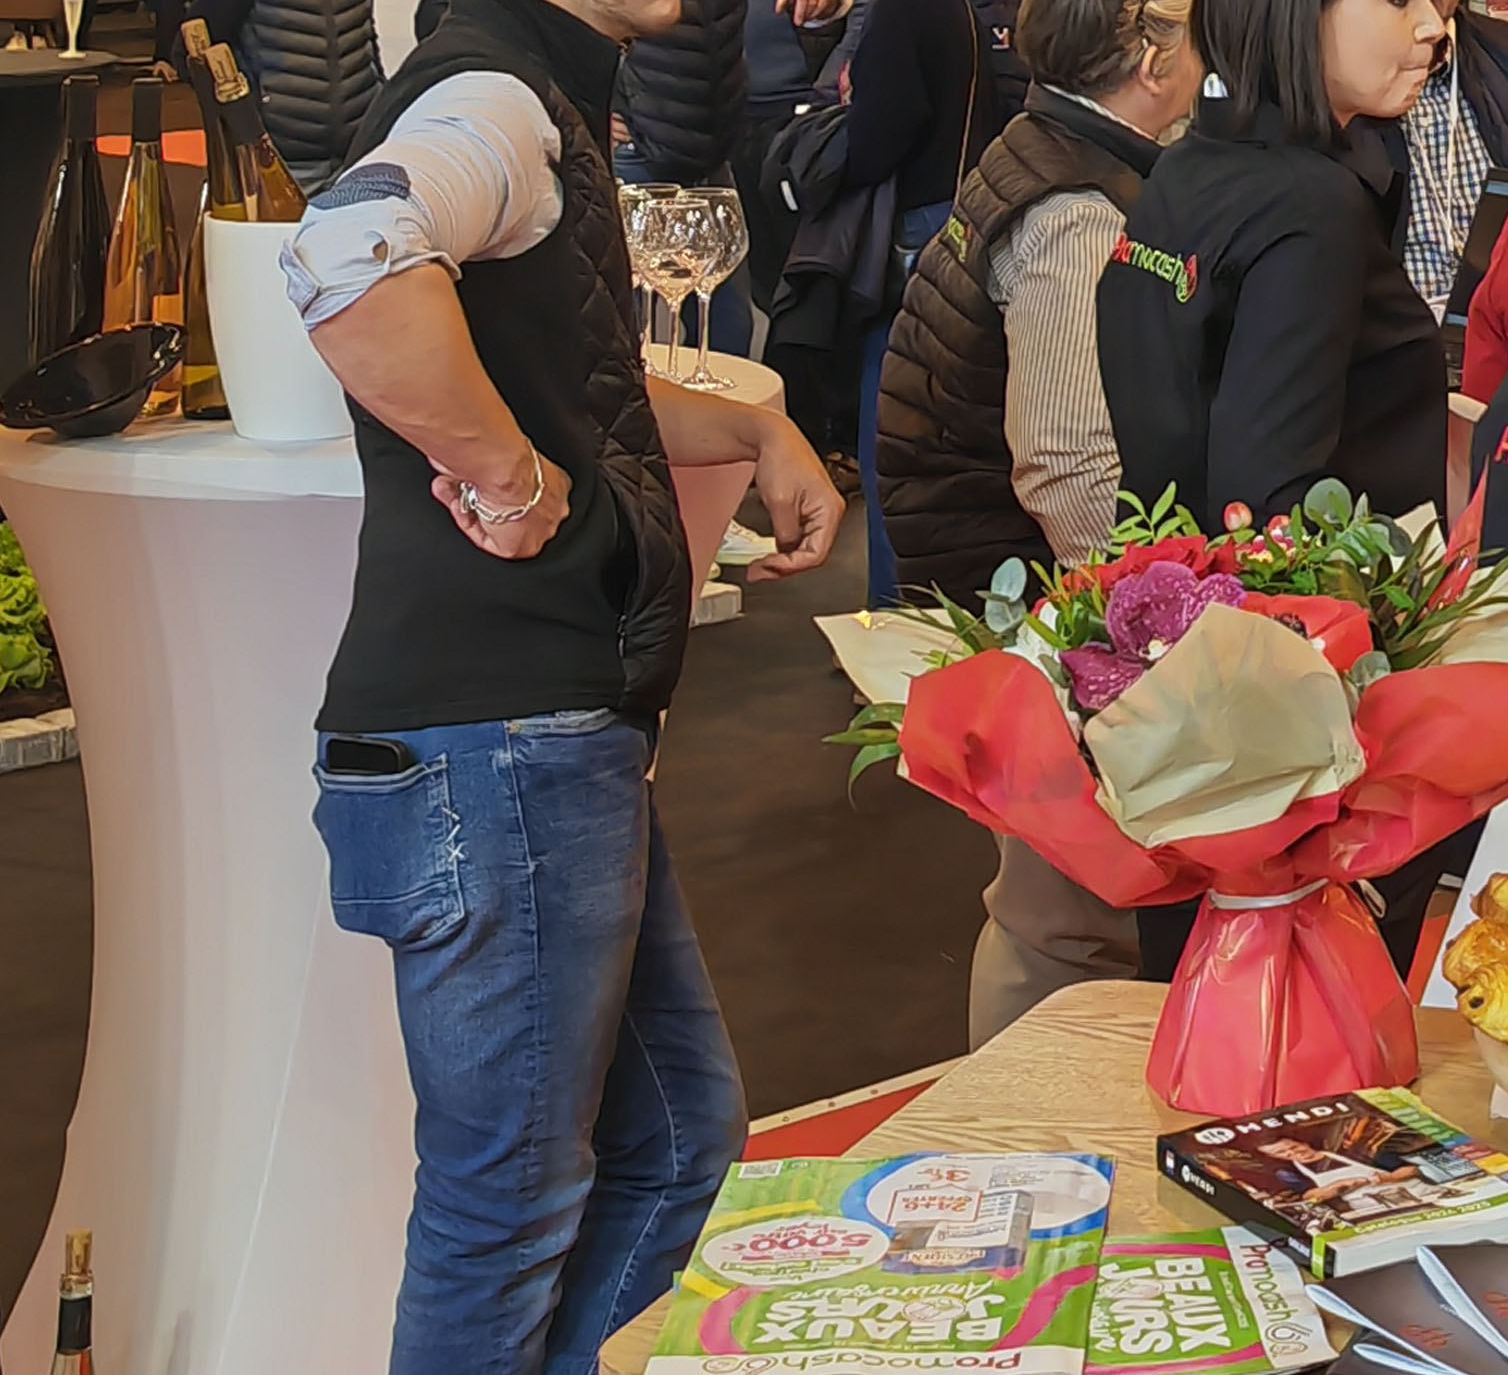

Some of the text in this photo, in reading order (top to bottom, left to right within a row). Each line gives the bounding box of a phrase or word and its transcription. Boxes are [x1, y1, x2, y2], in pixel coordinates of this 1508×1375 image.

[1237, 1102, 1350, 1135] HENDI
[1155, 1258, 1232, 1352] BEAUX
[753, 1317, 1002, 1344] BEAUX
[783, 1351, 1022, 1370] Promocash
